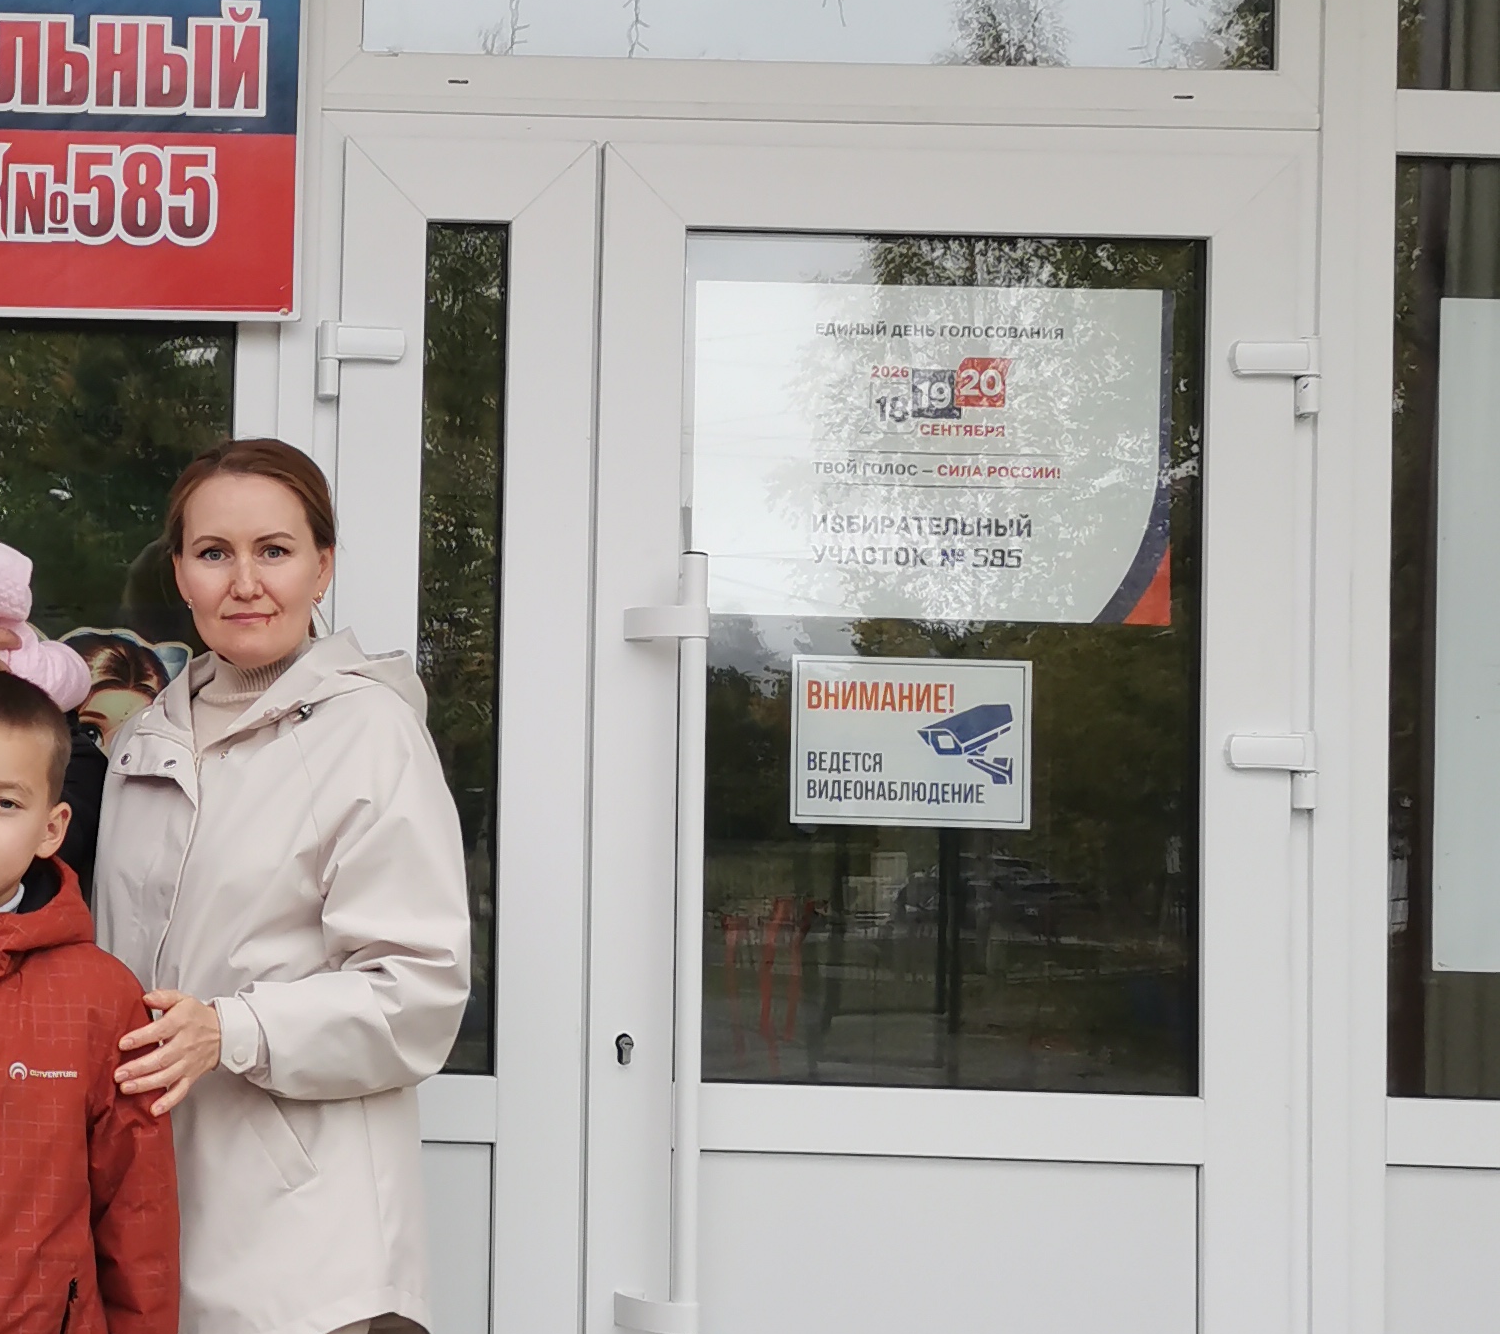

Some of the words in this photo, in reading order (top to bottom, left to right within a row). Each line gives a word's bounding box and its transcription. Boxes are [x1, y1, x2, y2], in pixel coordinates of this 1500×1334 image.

[815, 320, 887, 338] ЕДИНЫЙ
[891, 325, 934, 338] ДЕНЬ
[940, 325, 1064, 340] ГОЛОСОВАНИЯ
[870, 365, 909, 378] 2026
[875, 395, 912, 422] 18
[916, 381, 951, 409] 19
[959, 369, 1001, 396] 20
[920, 424, 1005, 437] СЕНТЯБРЯ
[813, 459, 857, 476] ТВОЙ
[863, 463, 918, 476] ГОЛОС
[937, 464, 983, 478] СИЛА
[988, 465, 1061, 479] РОССИИ!
[812, 514, 1032, 538] ИЗБИРАТЕЛЬНЫЙ
[812, 545, 927, 567] УЧАСТОК
[972, 548, 1023, 568] 585
[807, 679, 955, 713] ВНИМАНИЕ!
[807, 751, 883, 774] ВЕДЕТСЯ
[807, 780, 985, 805] ВИДЕОНАБЛЮДЕНИЕ
